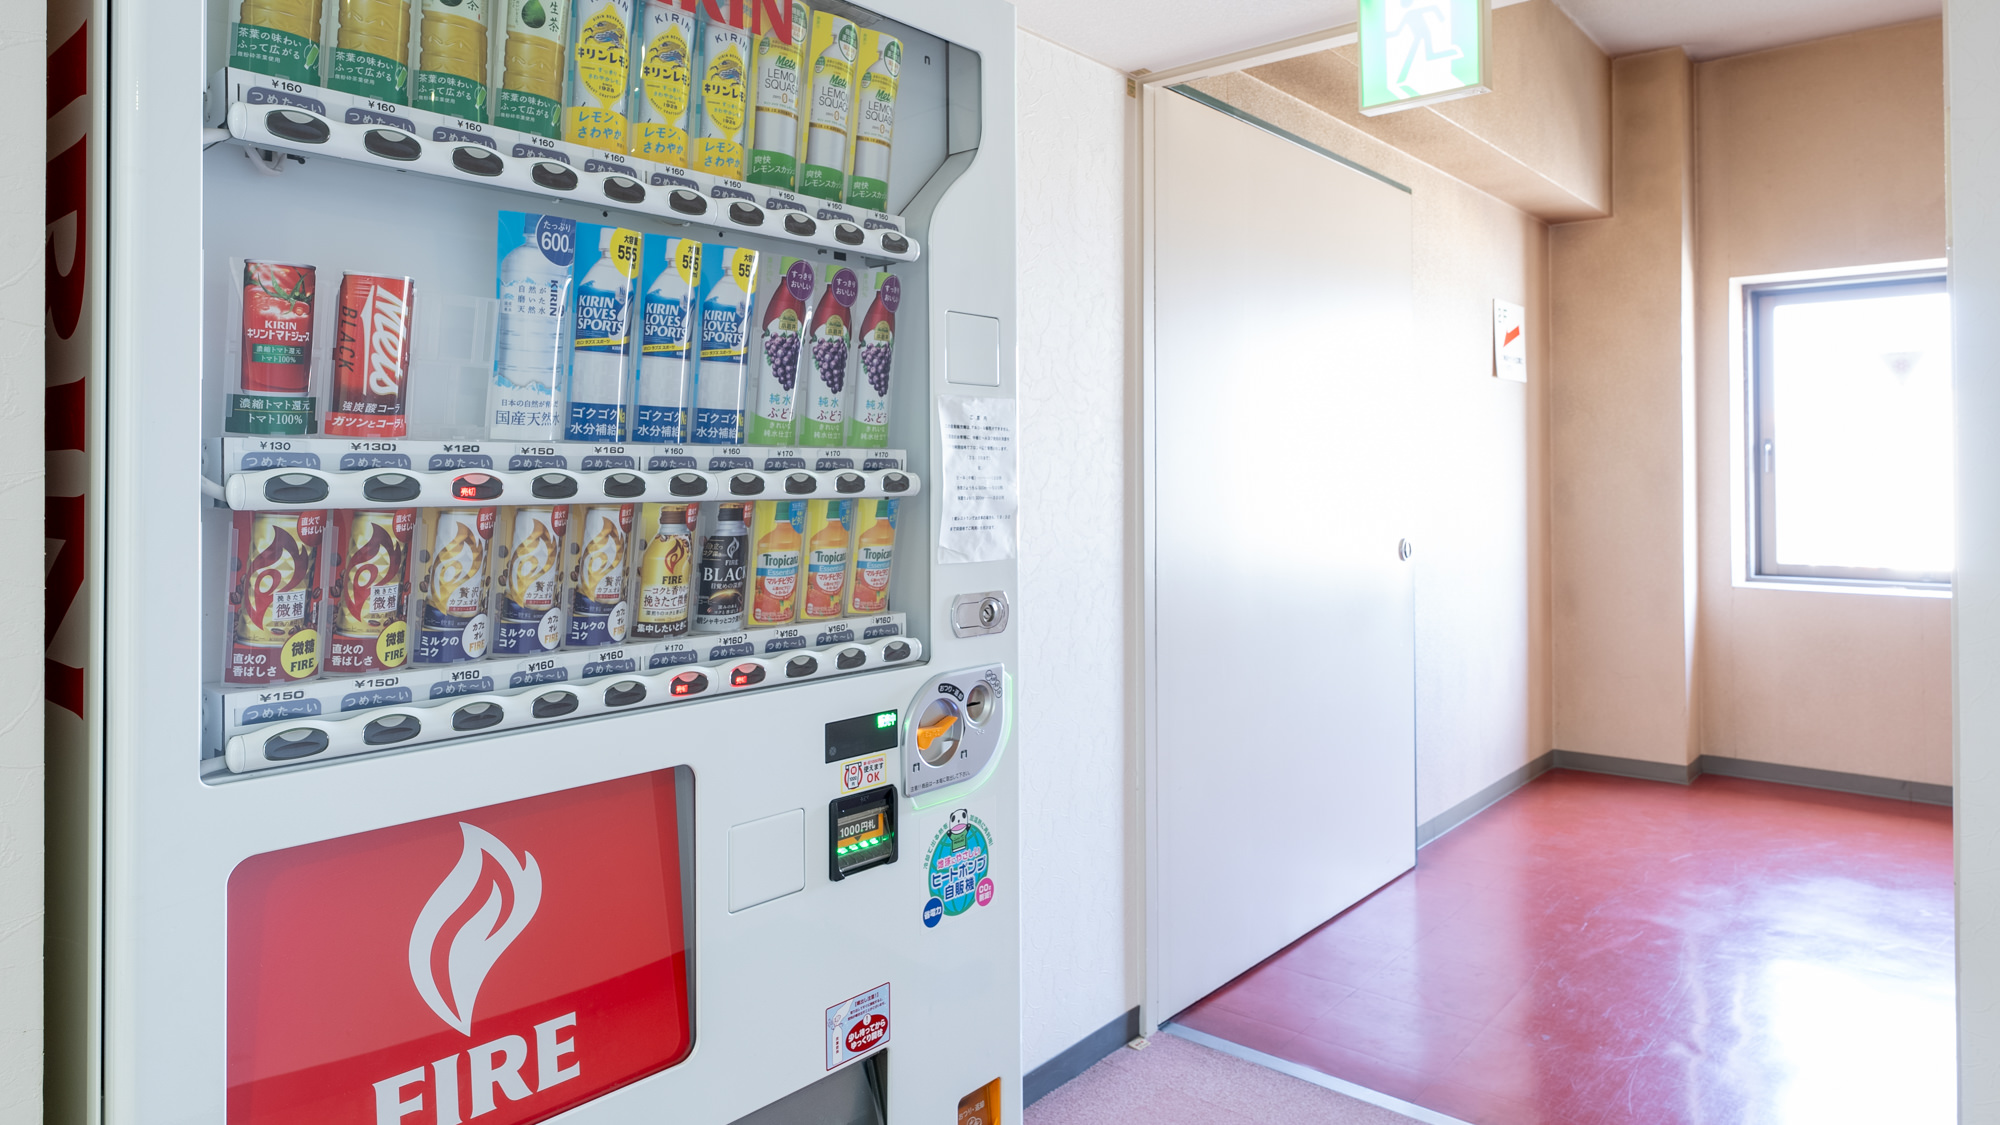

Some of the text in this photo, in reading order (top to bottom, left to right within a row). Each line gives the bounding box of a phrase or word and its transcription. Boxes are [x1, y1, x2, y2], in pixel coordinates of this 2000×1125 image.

[654, 13, 691, 33] KIRIN
[238, 27, 302, 47] 茶葉の味わい
[237, 39, 300, 60] ふって広がる
[335, 51, 393, 70] 茶葉の味わい
[578, 48, 629, 69] キリンレモン
[334, 63, 392, 82] ふって広がる
[643, 65, 690, 87] キリンレモン
[271, 79, 302, 93] ¥160
[418, 73, 473, 89] 茶葉の味わい
[418, 85, 472, 101] ふって広がる
[501, 91, 551, 108] 茶葉の味わい
[368, 100, 396, 114] ¥160
[500, 102, 549, 119] ふって広がる
[457, 119, 482, 133] ¥160
[532, 136, 555, 149] ¥160
[604, 152, 625, 164] ¥160
[754, 154, 771, 164] 爽快
[665, 166, 685, 177] ¥160
[806, 169, 823, 179] 爽快
[724, 180, 742, 189] ¥160
[853, 181, 869, 190] 爽快
[779, 191, 795, 201] ¥160
[543, 220, 571, 232] たっぷり
[791, 270, 813, 281] すっきり
[791, 281, 812, 290] おいしい
[549, 280, 559, 317] KIRIN
[578, 295, 615, 309] KIRIN
[578, 307, 617, 320] LOVES
[646, 302, 679, 316] KIRIN
[646, 314, 681, 327] LOVES
[704, 309, 736, 322] KIRIN
[264, 320, 297, 331] KIRIN
[577, 318, 624, 333] SPORTS
[703, 321, 738, 333] LOVES
[247, 328, 310, 342] キリントマトジュース
[645, 325, 687, 339] SPORTS
[703, 330, 744, 344] SPORTS
[338, 305, 358, 373] BLACK
[261, 355, 297, 363] トマト100%
[239, 397, 311, 411] 濃縮トマト還元
[769, 393, 792, 405] 純水
[818, 396, 839, 408] 純水
[866, 400, 885, 410] 純水
[342, 400, 401, 414] 強炭酸コーラ
[248, 414, 303, 425] トマト100%
[495, 410, 560, 427] 国産天然水
[572, 406, 618, 421] ゴクゴク
[640, 410, 681, 422] ゴクゴク
[698, 412, 739, 425] ゴクゴク
[570, 422, 618, 436] 水分補給
[637, 425, 680, 438] 水分補給
[696, 427, 738, 439] 水分補給
[259, 441, 291, 451] ¥130
[443, 444, 480, 453] ¥120
[521, 447, 554, 455] ¥150
[594, 446, 625, 454] ¥160
[460, 487, 476, 497] 売切
[301, 516, 320, 526] 直火で
[396, 514, 412, 524] 直火で
[604, 576, 621, 588] 贅沢
[661, 575, 683, 585] FIRE
[458, 587, 480, 599] 贅沢
[535, 581, 554, 593] 贅沢
[373, 596, 397, 610] 微糖
[449, 598, 478, 606] カフェオレ
[276, 604, 304, 617] 微糖
[572, 621, 606, 631] ミルクの
[875, 616, 892, 624] ¥160
[500, 627, 535, 637] ミルクの
[612, 625, 625, 637] FIRE
[779, 629, 798, 638] ¥160
[828, 624, 846, 633] ¥160
[386, 630, 405, 647] 微糖
[421, 636, 459, 646] ミルクの
[544, 632, 559, 644] FIRE
[571, 632, 588, 641] コク
[723, 636, 743, 645] ¥160
[291, 638, 315, 656] 微糖
[332, 643, 364, 654] 直火の
[469, 639, 485, 652] FIRE
[499, 639, 517, 648] コク
[664, 644, 684, 652] ¥170
[384, 647, 405, 661] FIRE
[420, 647, 439, 657] コク
[599, 650, 623, 662] ¥160
[233, 653, 266, 665] 直火の
[290, 658, 315, 672] FIRE
[331, 655, 373, 666] 香ばしさ
[232, 666, 277, 677] 香ばしさ
[528, 660, 554, 672] ¥160
[451, 670, 480, 681] ¥160
[259, 690, 304, 702] ¥150
[863, 763, 884, 773] 使えます
[867, 771, 880, 783] OK
[840, 819, 876, 838] 1000円札
[932, 855, 986, 888] ヒートポンプ
[944, 877, 975, 901] 自販機
[848, 1019, 886, 1043] 少し待ってから
[372, 1011, 581, 1125] FIRE
